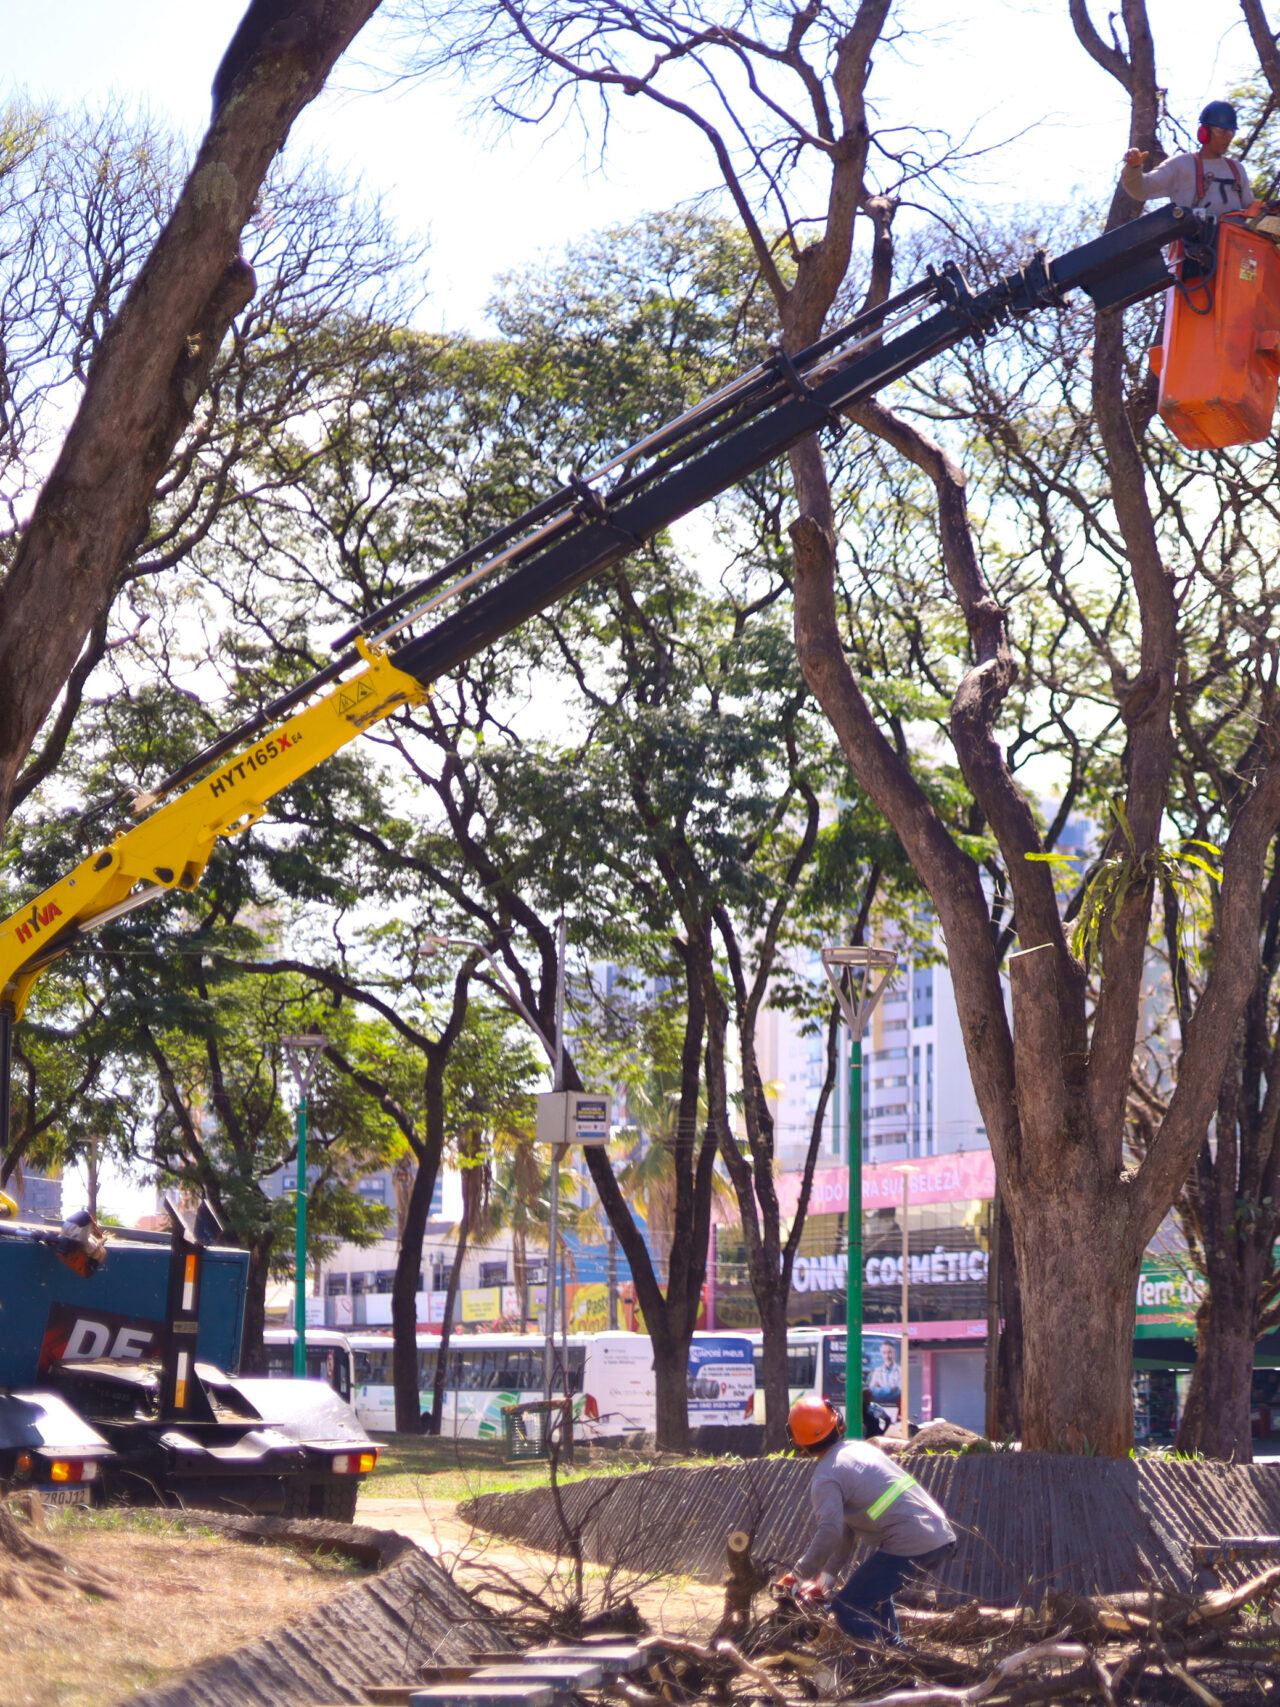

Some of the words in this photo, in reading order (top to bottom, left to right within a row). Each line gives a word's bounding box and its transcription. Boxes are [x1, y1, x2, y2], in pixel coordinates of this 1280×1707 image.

[15, 902, 63, 944] HYVA
[811, 1184, 844, 1202] TUDO
[910, 1172, 962, 1193] BELEZA
[865, 1245, 989, 1286] COSMÉTIC
[1136, 1273, 1175, 1306] Tem
